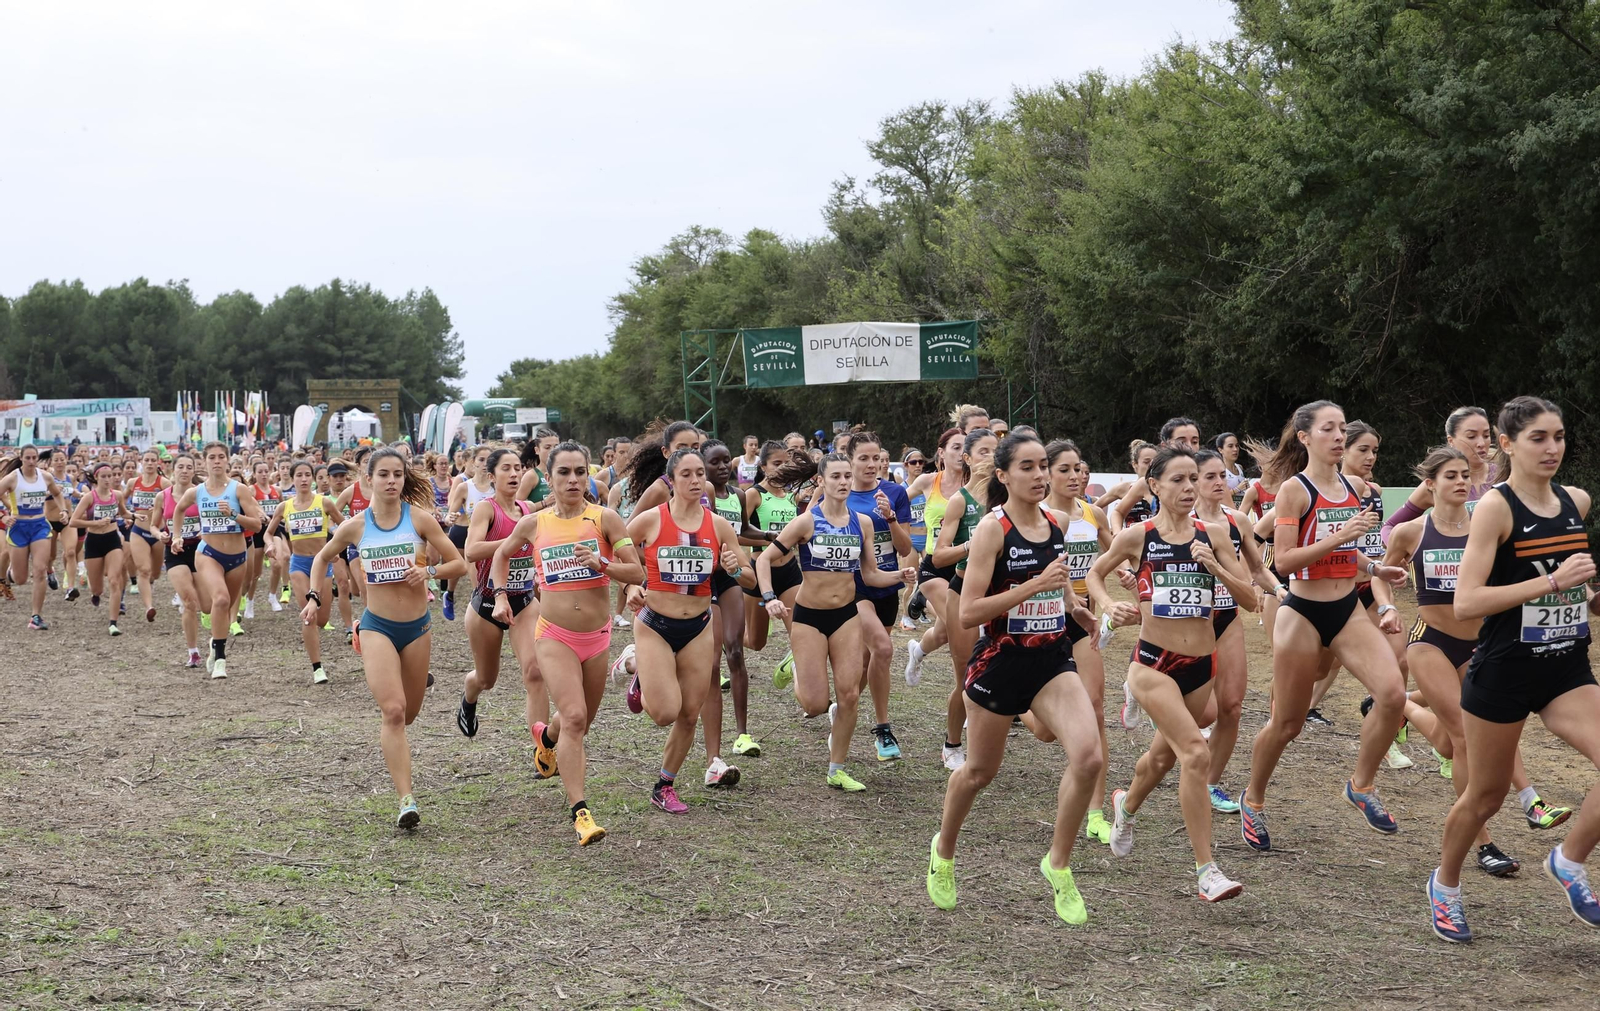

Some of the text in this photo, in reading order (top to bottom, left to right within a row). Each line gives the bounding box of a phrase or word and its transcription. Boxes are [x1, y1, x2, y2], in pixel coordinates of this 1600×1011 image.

[810, 334, 913, 350] DIPUTACIÓN DE
[926, 334, 972, 345] DIPUTACION
[751, 340, 797, 354] DIPUTACION
[836, 356, 889, 369] SEVILLA
[927, 355, 971, 363] SEVILLA
[753, 362, 798, 371] SEVILLA
[81, 402, 134, 414] ITÁLICA
[207, 518, 230, 527] 1896
[295, 518, 318, 529] 3274
[1327, 522, 1346, 537] 36
[370, 546, 404, 557] ITÁLICA
[552, 546, 575, 556] ITÁLI
[669, 547, 702, 557] ITÁLICA
[825, 547, 850, 559] 304
[1438, 550, 1462, 561] ITÁLI
[371, 558, 406, 570] ROMERO
[546, 558, 581, 573] NAVARR
[1330, 555, 1348, 565] FER
[668, 559, 704, 573] 1115
[1179, 563, 1198, 572] BM
[509, 569, 529, 581] 567
[672, 574, 699, 582] Joma
[1069, 569, 1088, 578] oma
[506, 581, 524, 589] oma
[1167, 574, 1205, 585] ITÁLICA
[1169, 588, 1202, 605] 823
[1213, 586, 1230, 596] SPE
[1213, 598, 1233, 606] oma
[1018, 602, 1035, 616] AIT
[1537, 606, 1582, 626] 2184
[1023, 618, 1058, 632] Joma
